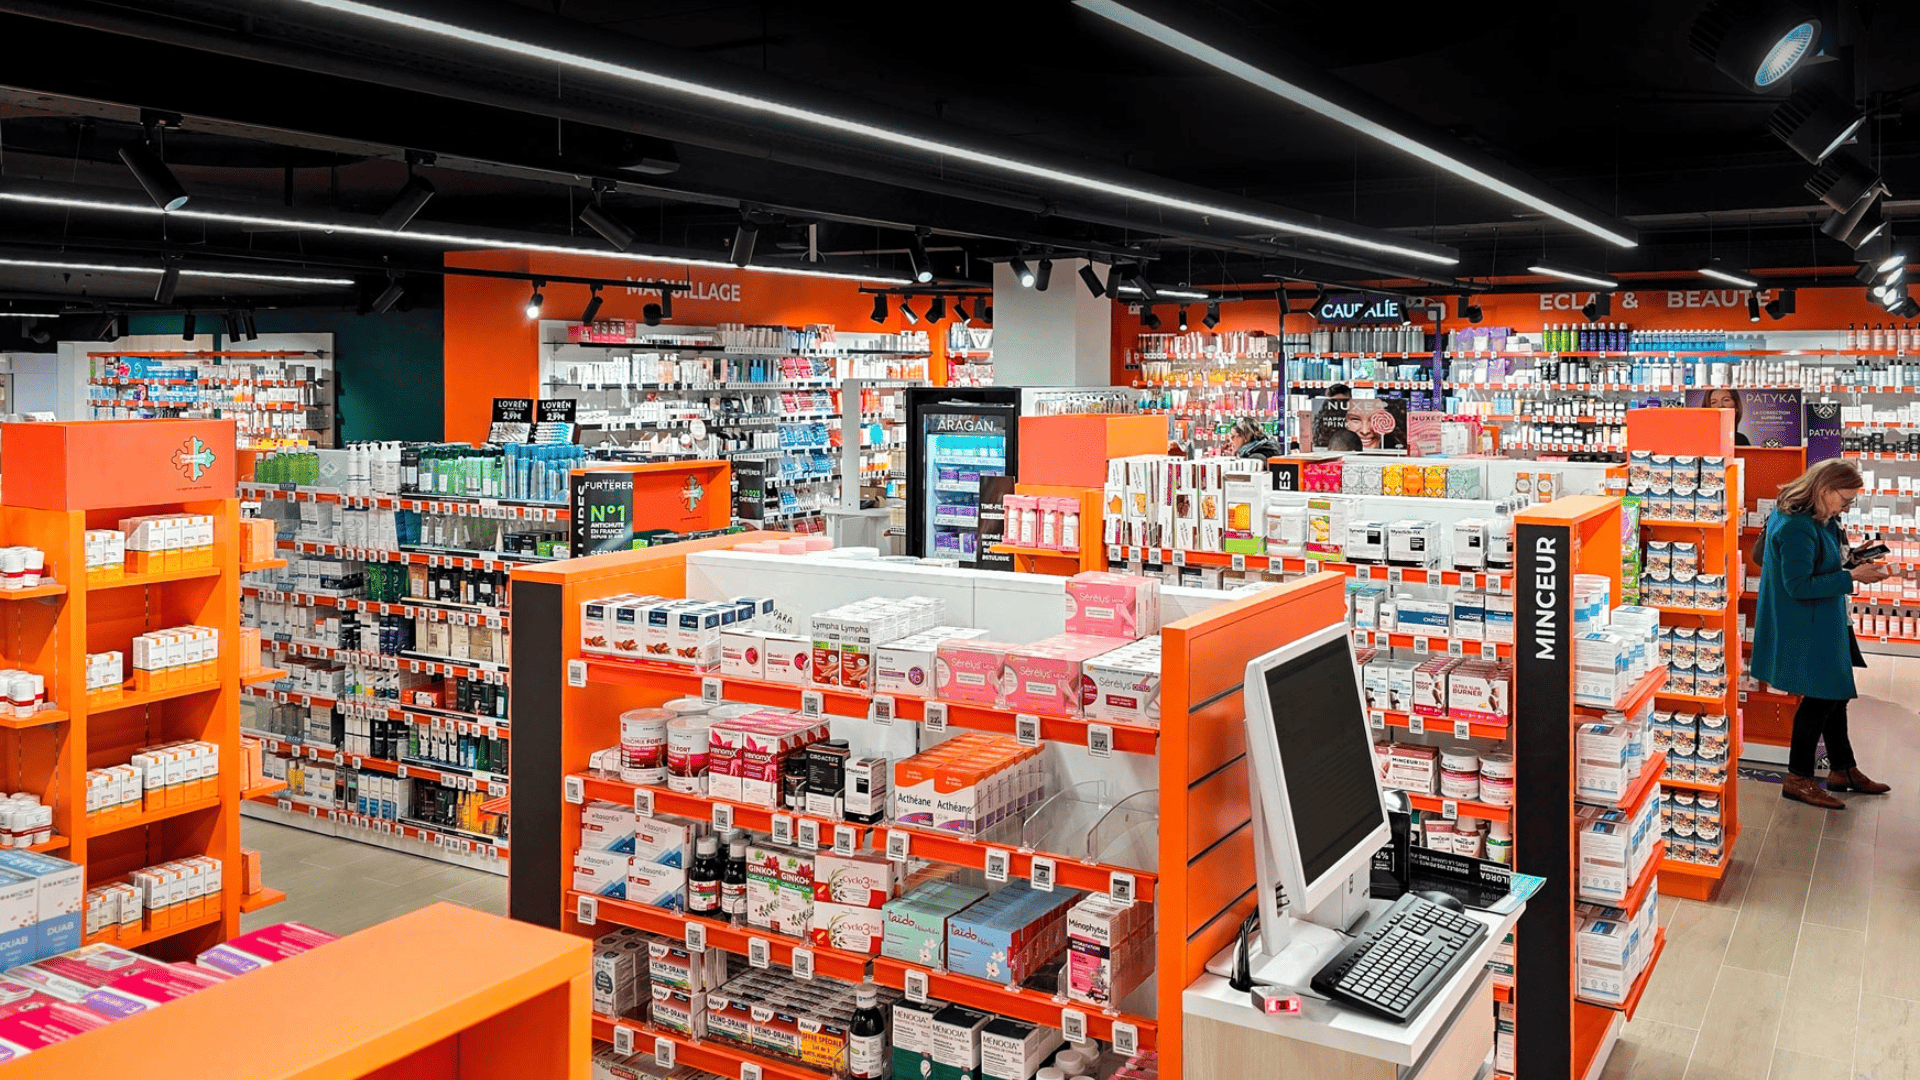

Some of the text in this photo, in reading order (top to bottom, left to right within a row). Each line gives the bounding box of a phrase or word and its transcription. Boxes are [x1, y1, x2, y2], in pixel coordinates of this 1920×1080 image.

[1539, 292, 1615, 311] ECLA
[1622, 291, 1639, 309] &
[499, 400, 528, 409] LOVRÉN
[1746, 393, 1798, 404] PATYKA
[542, 401, 571, 410] LOVRÉN
[1328, 401, 1374, 411] NUXE
[1809, 429, 1841, 438] PATYKA
[585, 481, 633, 490] FURTERER
[1079, 592, 1110, 604] Sérélys
[1535, 536, 1556, 660] MINCEUR
[812, 620, 839, 631] Lympha
[840, 623, 869, 636] Lympha
[1019, 667, 1050, 679] Sérélys
[1099, 677, 1132, 691] Sérélys
[1452, 688, 1482, 697] BURNER
[646, 737, 663, 745] FORT
[1392, 757, 1418, 765] MINCEUR
[898, 793, 931, 806] Acthéane
[937, 800, 972, 814] Acthéane
[748, 864, 777, 877] GINKO+
[781, 872, 810, 885] GINKO+
[1480, 872, 1510, 885] ILORGA
[651, 961, 688, 977] VEINO-DRAINE
[654, 1005, 688, 1021] VEINO-DRAINE
[709, 1014, 749, 1031] VEINO-DRAINE
[753, 1025, 794, 1042] VEINO-DRAINE
